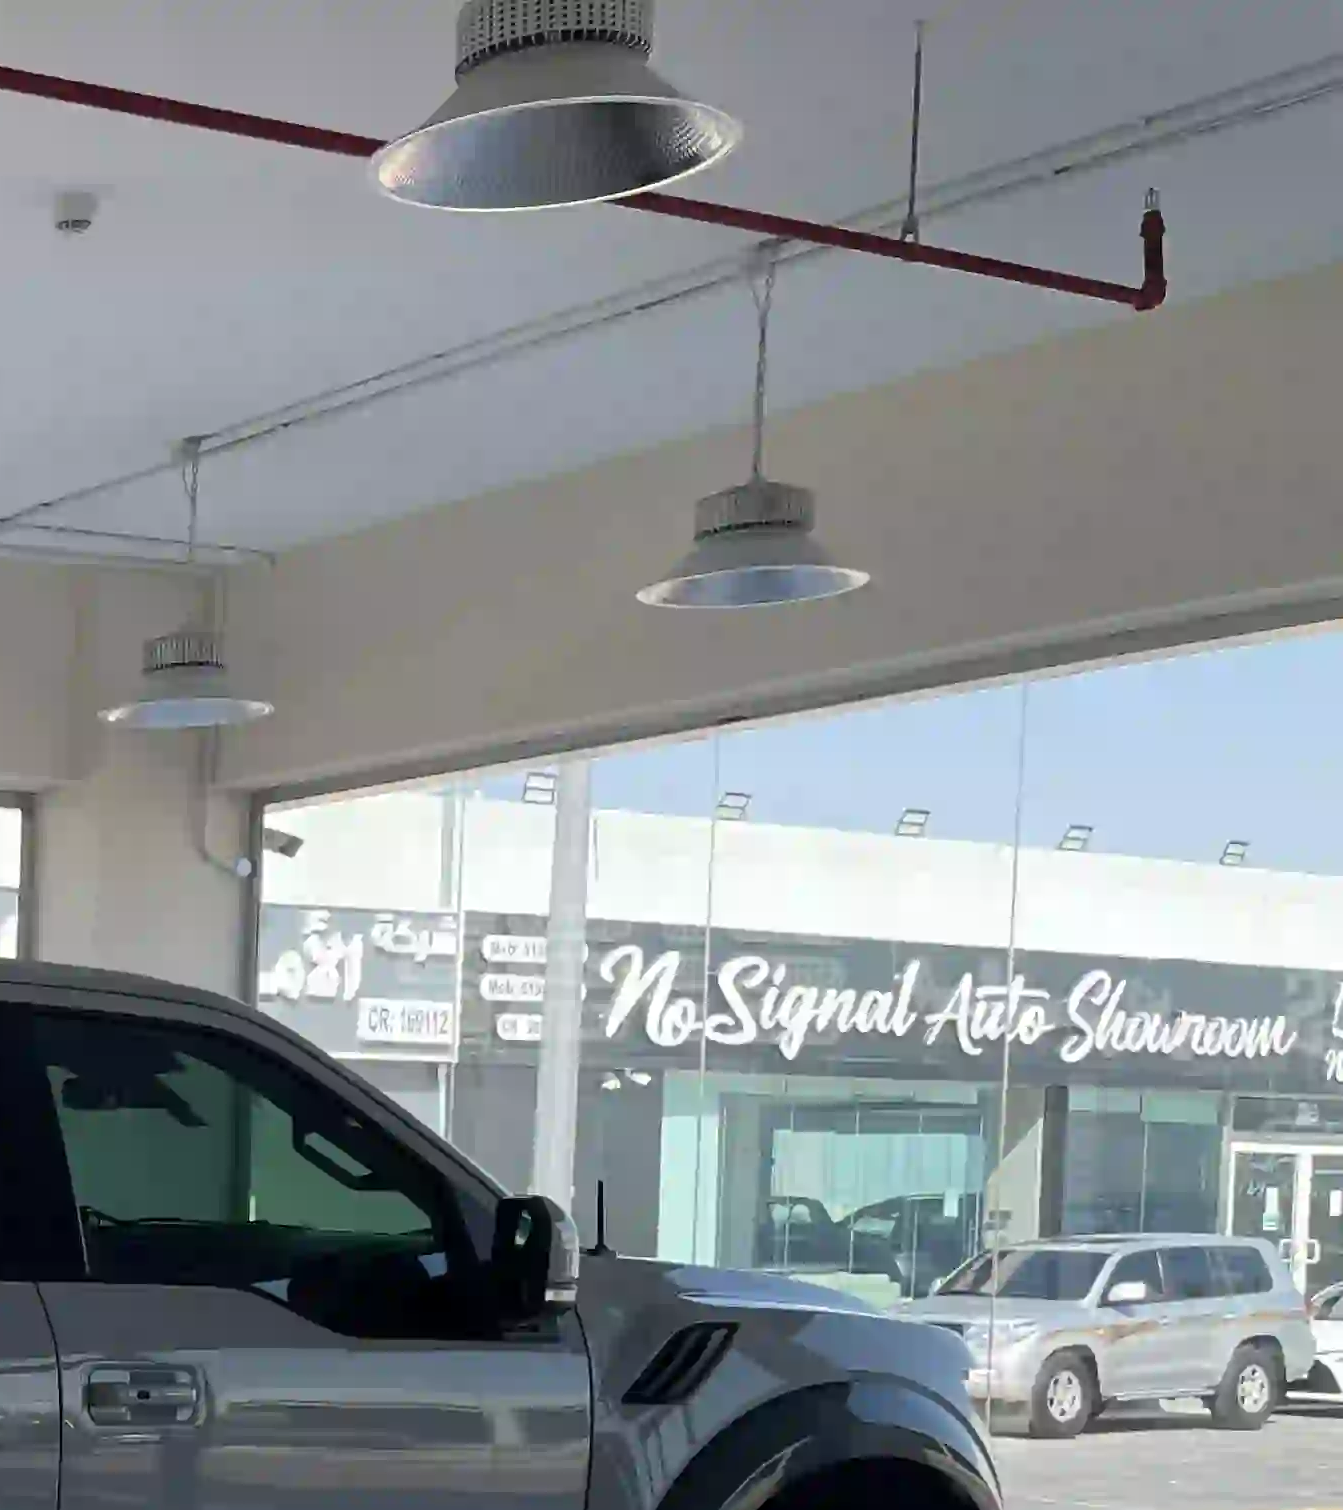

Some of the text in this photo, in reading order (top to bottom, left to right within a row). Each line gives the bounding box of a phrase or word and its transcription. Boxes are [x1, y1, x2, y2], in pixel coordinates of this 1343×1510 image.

[599, 945, 704, 1047] No
[705, 955, 921, 1061] Signal
[924, 971, 1056, 1056] Auto
[1059, 968, 1299, 1063] Showroom
